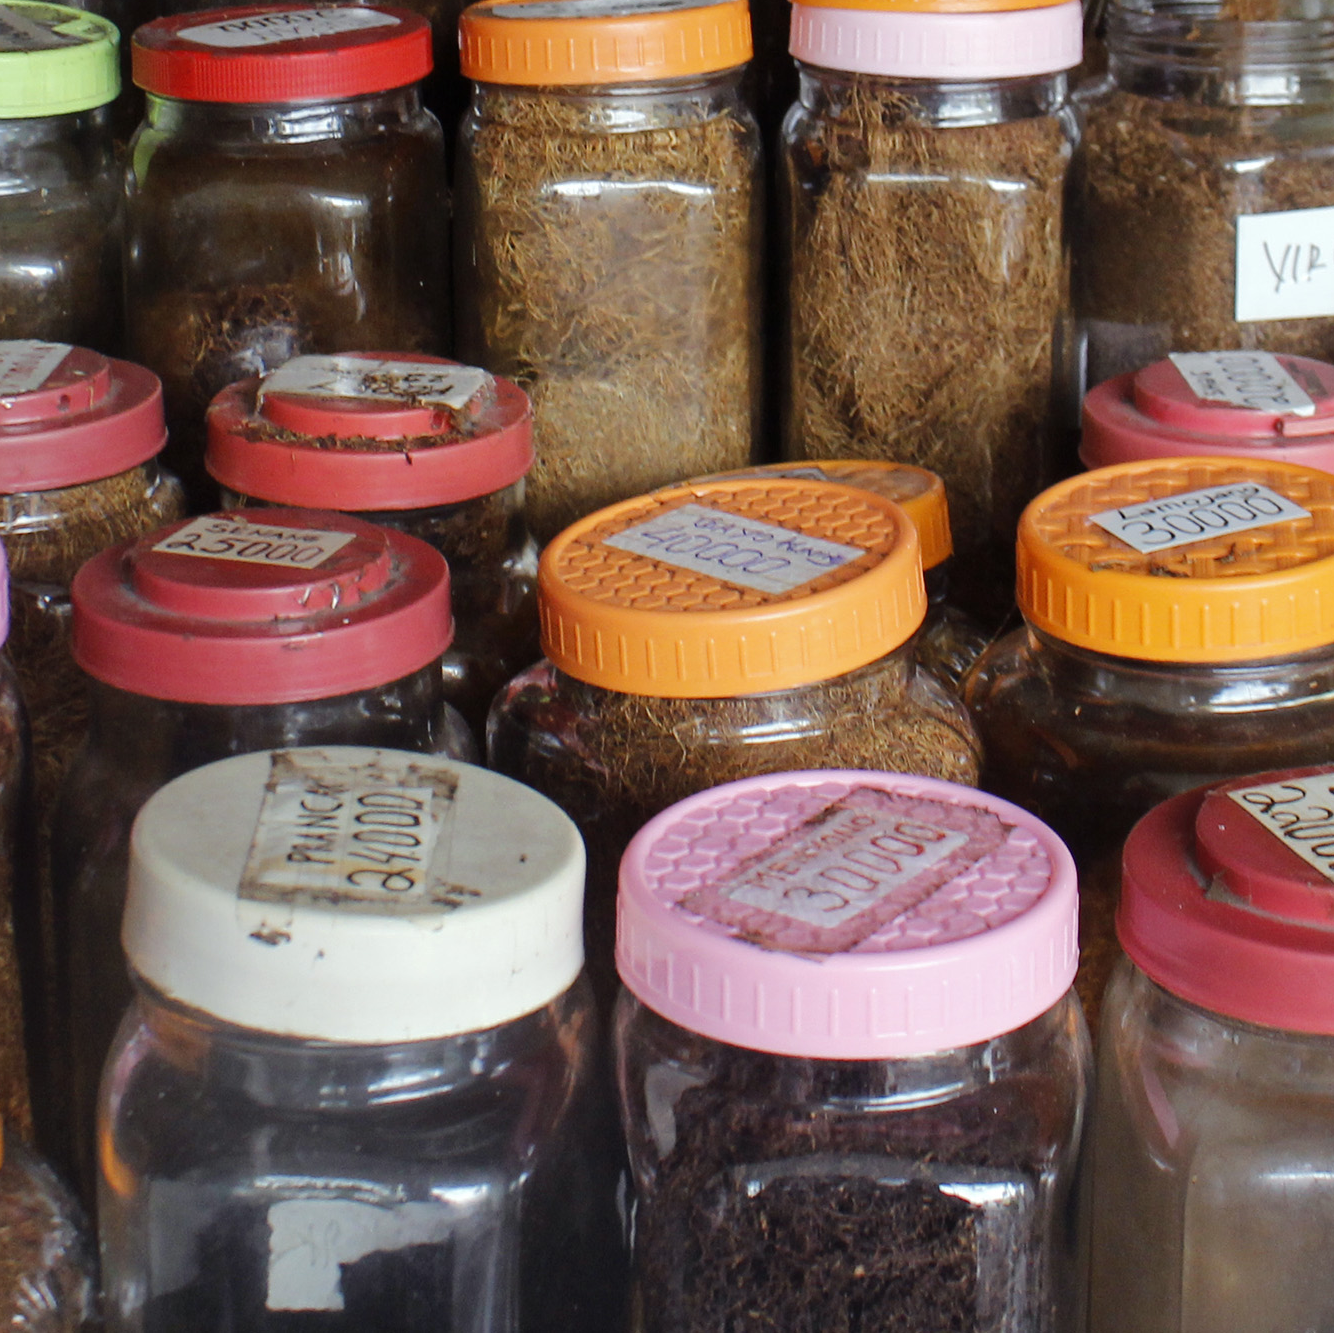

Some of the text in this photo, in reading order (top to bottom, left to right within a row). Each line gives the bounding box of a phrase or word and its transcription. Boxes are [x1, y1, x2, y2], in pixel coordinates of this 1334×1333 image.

[1121, 496, 1284, 545] 30000
[166, 532, 324, 564] 25000
[782, 822, 946, 912] 30000
